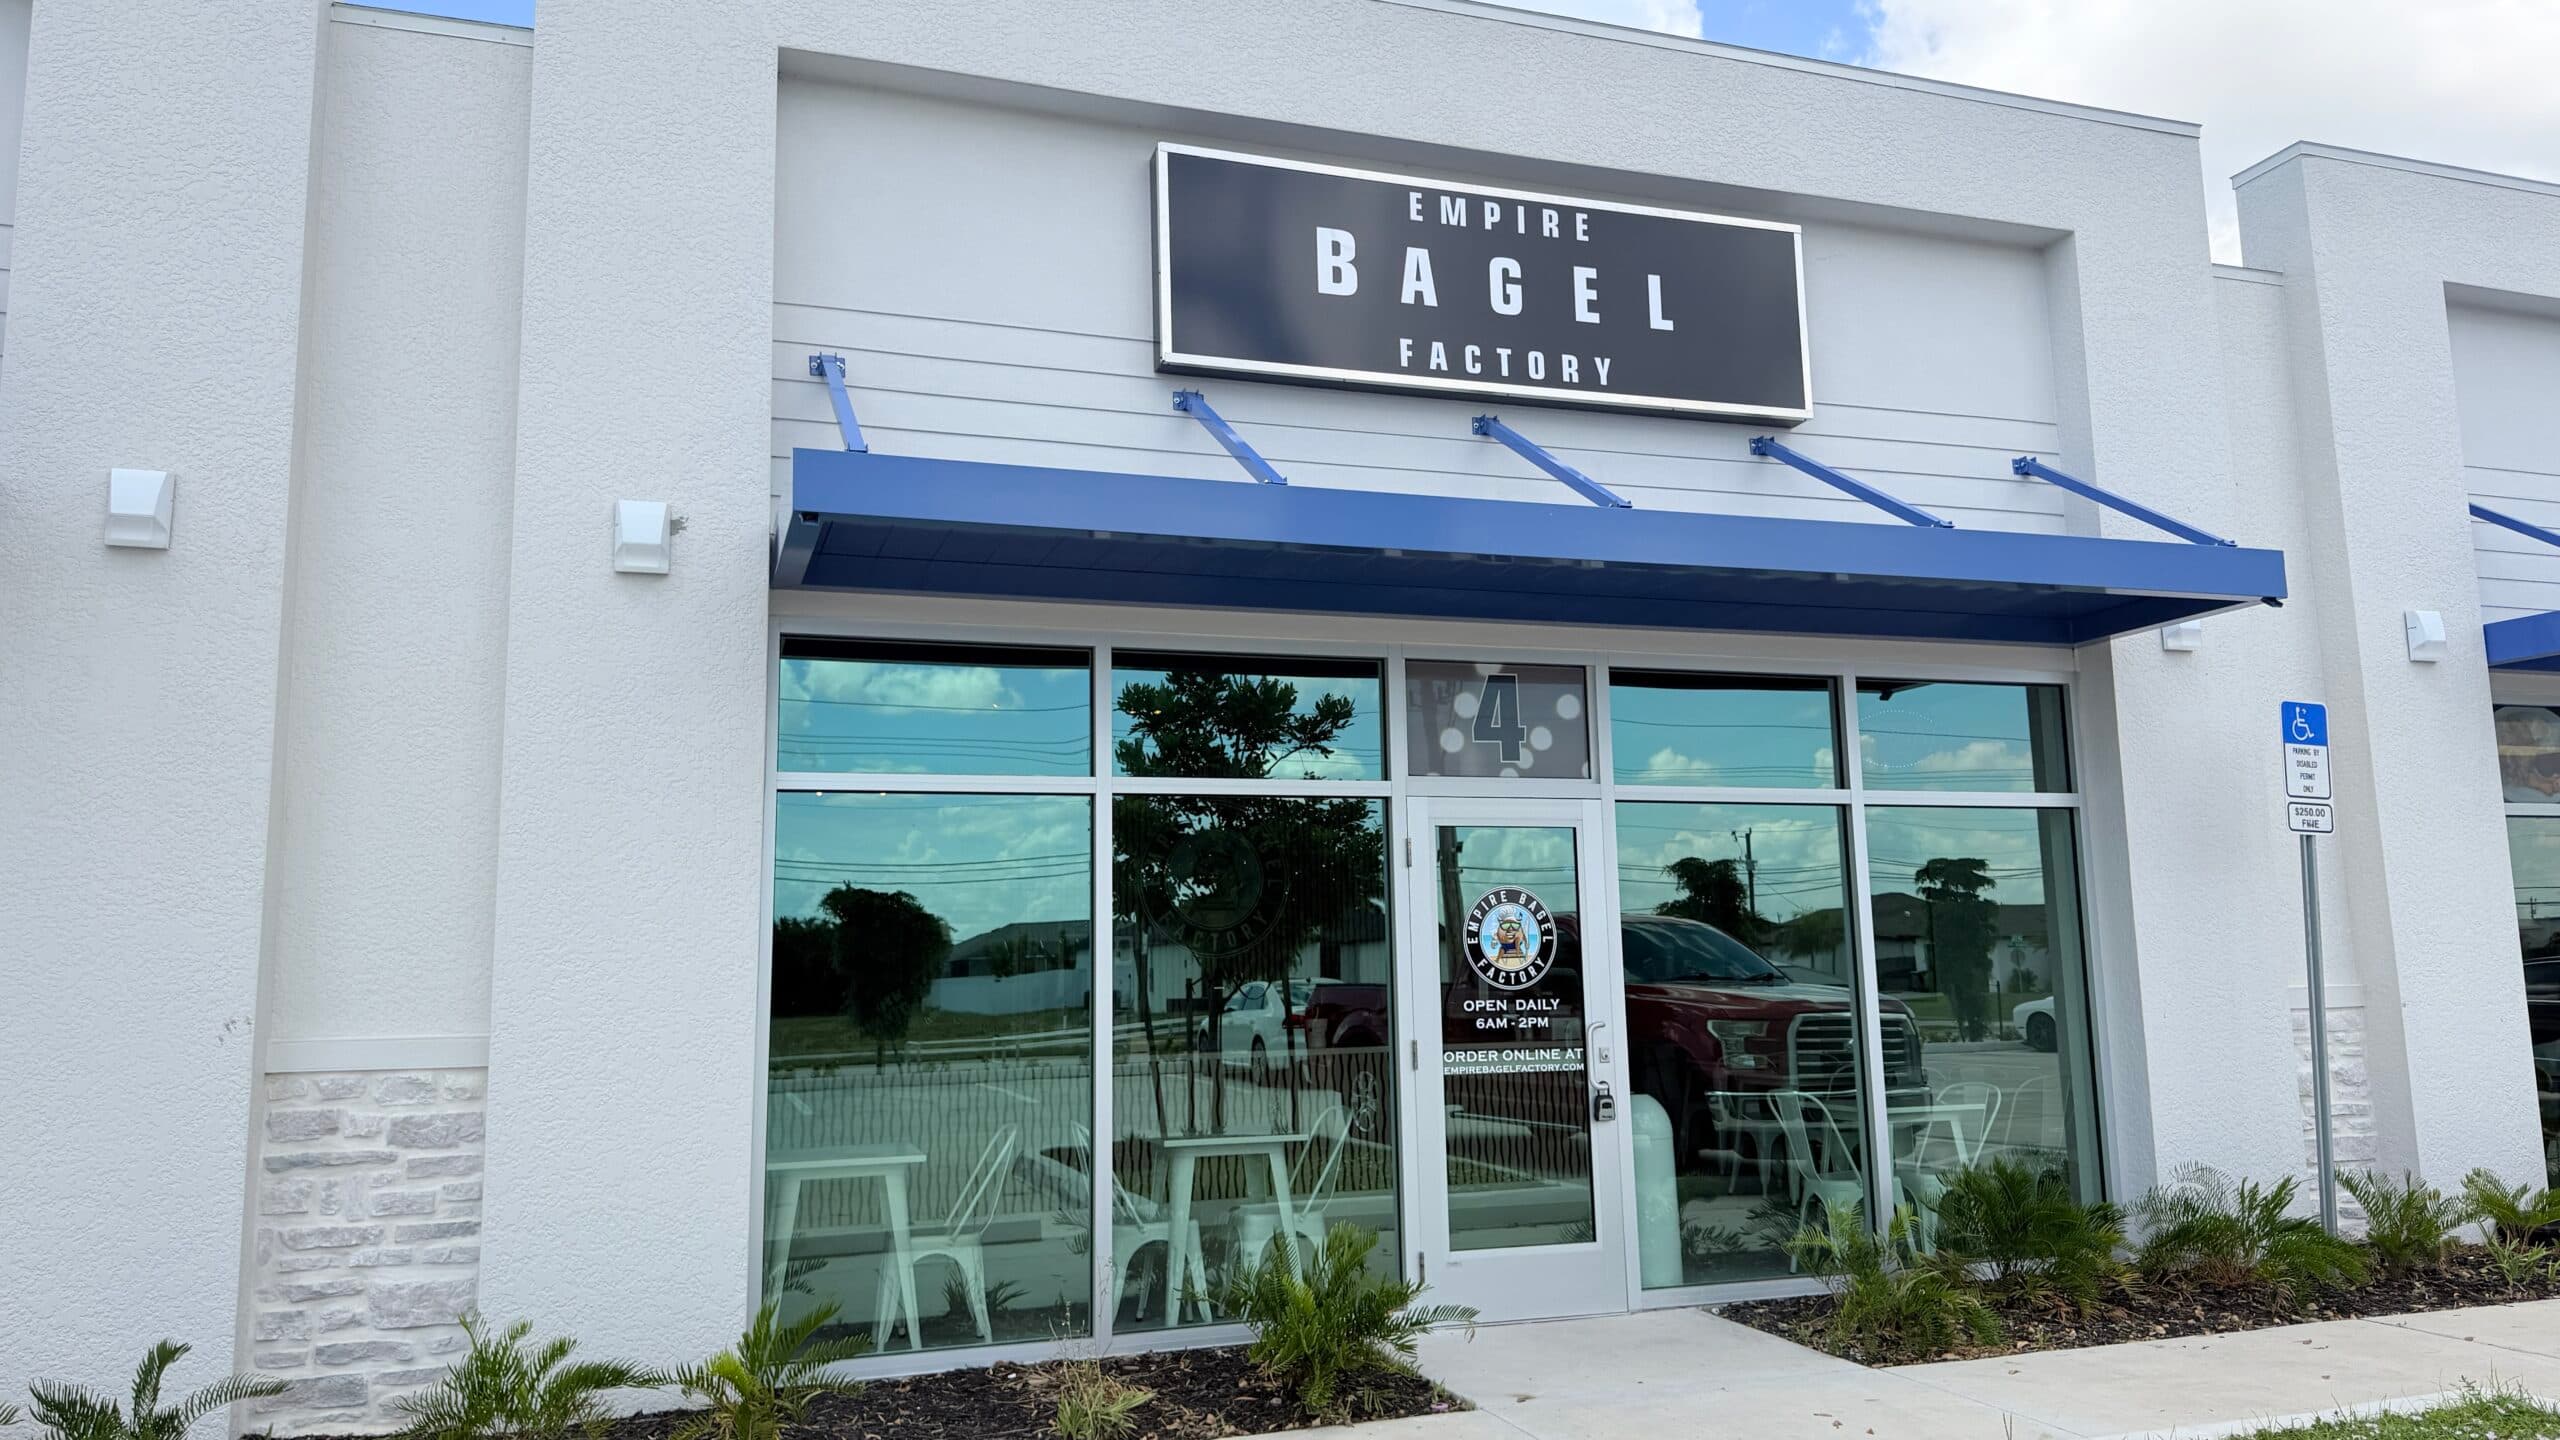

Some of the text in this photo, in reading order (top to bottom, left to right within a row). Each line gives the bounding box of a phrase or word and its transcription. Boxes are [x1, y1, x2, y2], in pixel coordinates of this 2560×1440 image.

[1409, 191, 1590, 243] EMPIRE
[1316, 226, 1675, 332] BAGEL
[1399, 337, 1613, 386] FACTORY
[1472, 674, 1526, 763] 4
[2293, 748, 2311, 756] PARKING
[2297, 760, 2317, 768] DISABLED
[2303, 785, 2313, 793] ONLY
[2295, 807, 2325, 817] $250.00
[1467, 890, 1554, 944] EMPIRE BAGEL
[1477, 957, 1545, 985] FACTORY
[1463, 999, 1560, 1012] OPEN DAILY
[1476, 1018, 1508, 1029] 6AM
[1518, 1017, 1549, 1028] 2PM
[1444, 1048, 1584, 1063] ORDER ONLINE AT
[1444, 1063, 1585, 1075] EMPIREBAGELFACTORY.COM
